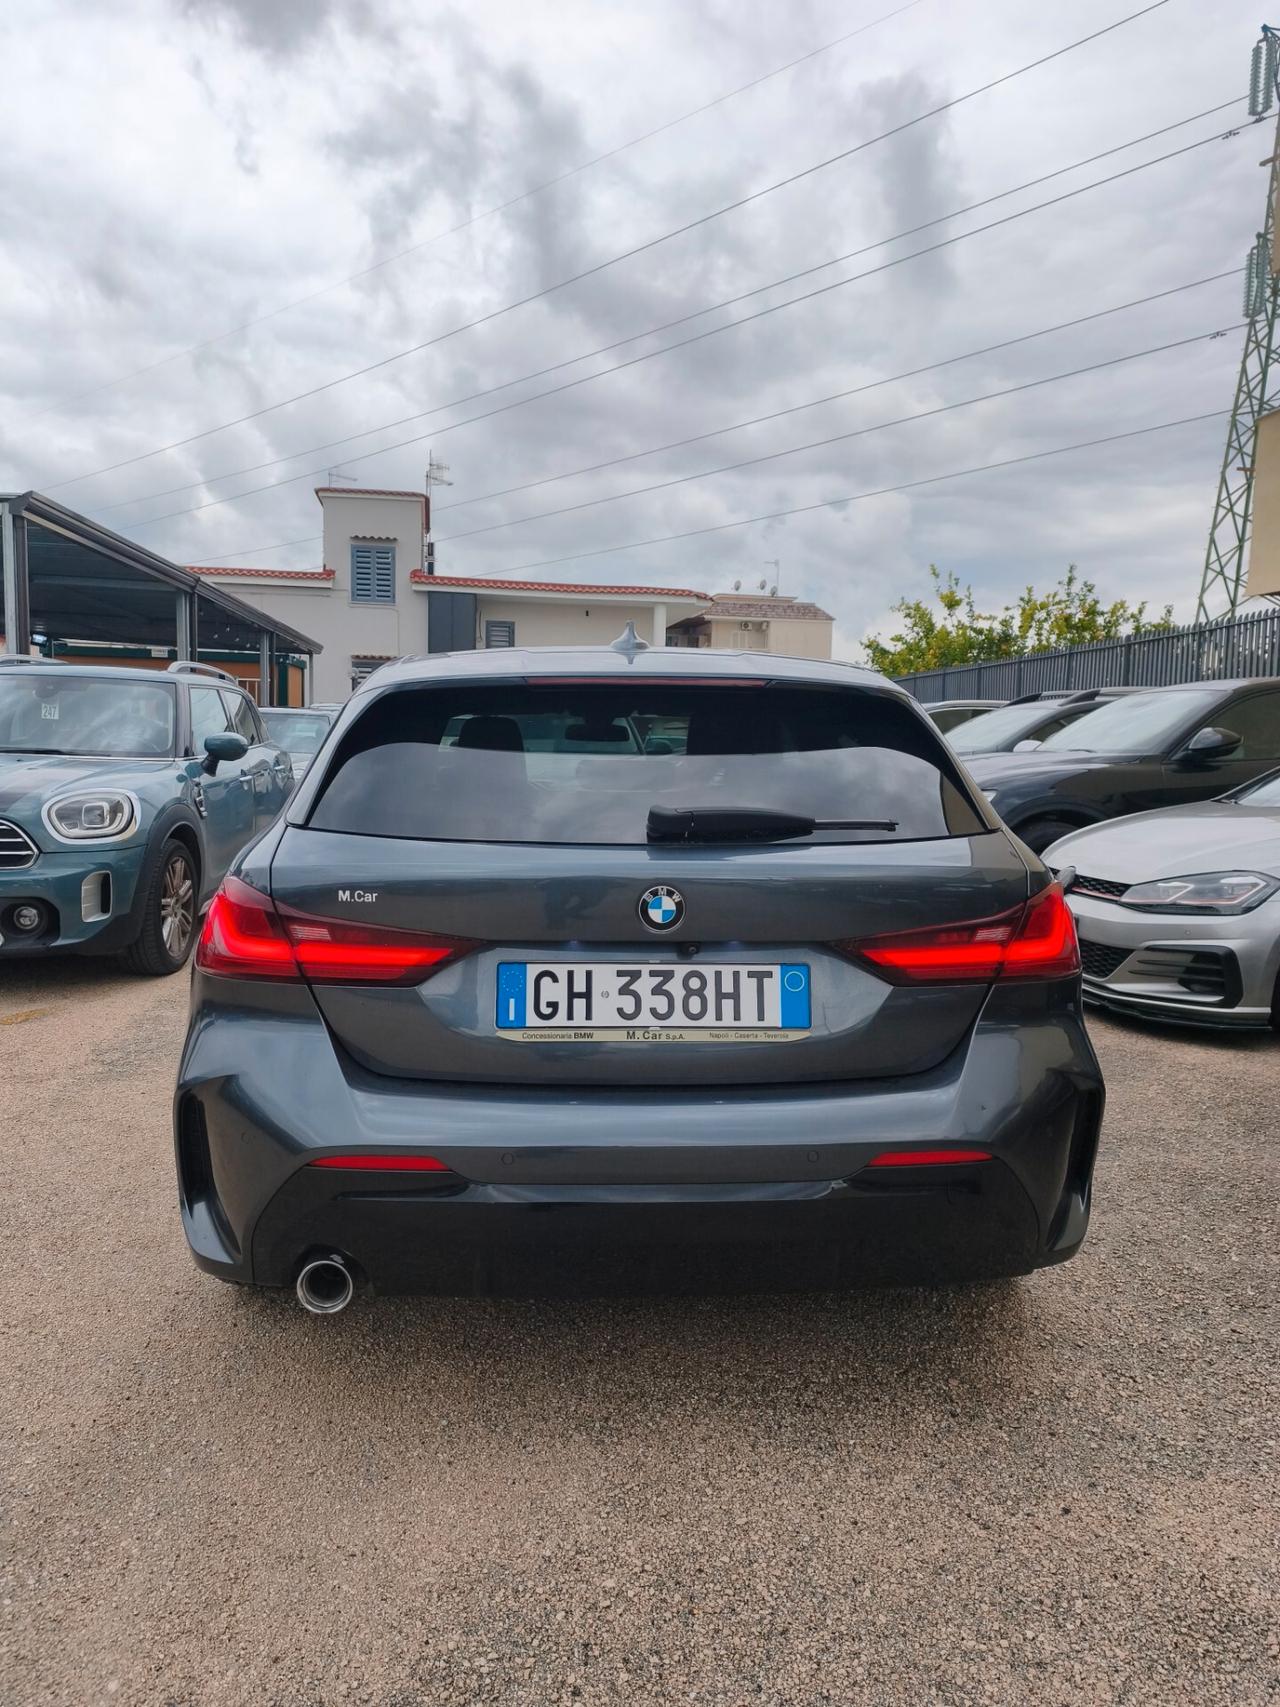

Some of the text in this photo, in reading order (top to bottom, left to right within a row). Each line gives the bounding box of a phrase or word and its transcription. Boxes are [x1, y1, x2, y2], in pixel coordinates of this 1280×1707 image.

[338, 890, 378, 902] M.Car
[644, 887, 681, 902] BMW
[533, 969, 774, 1022] GH 338HT
[522, 1032, 572, 1040] Concessionaria
[626, 1031, 640, 1041] M.
[642, 1031, 663, 1041] Car
[709, 1031, 729, 1040] Napoli
